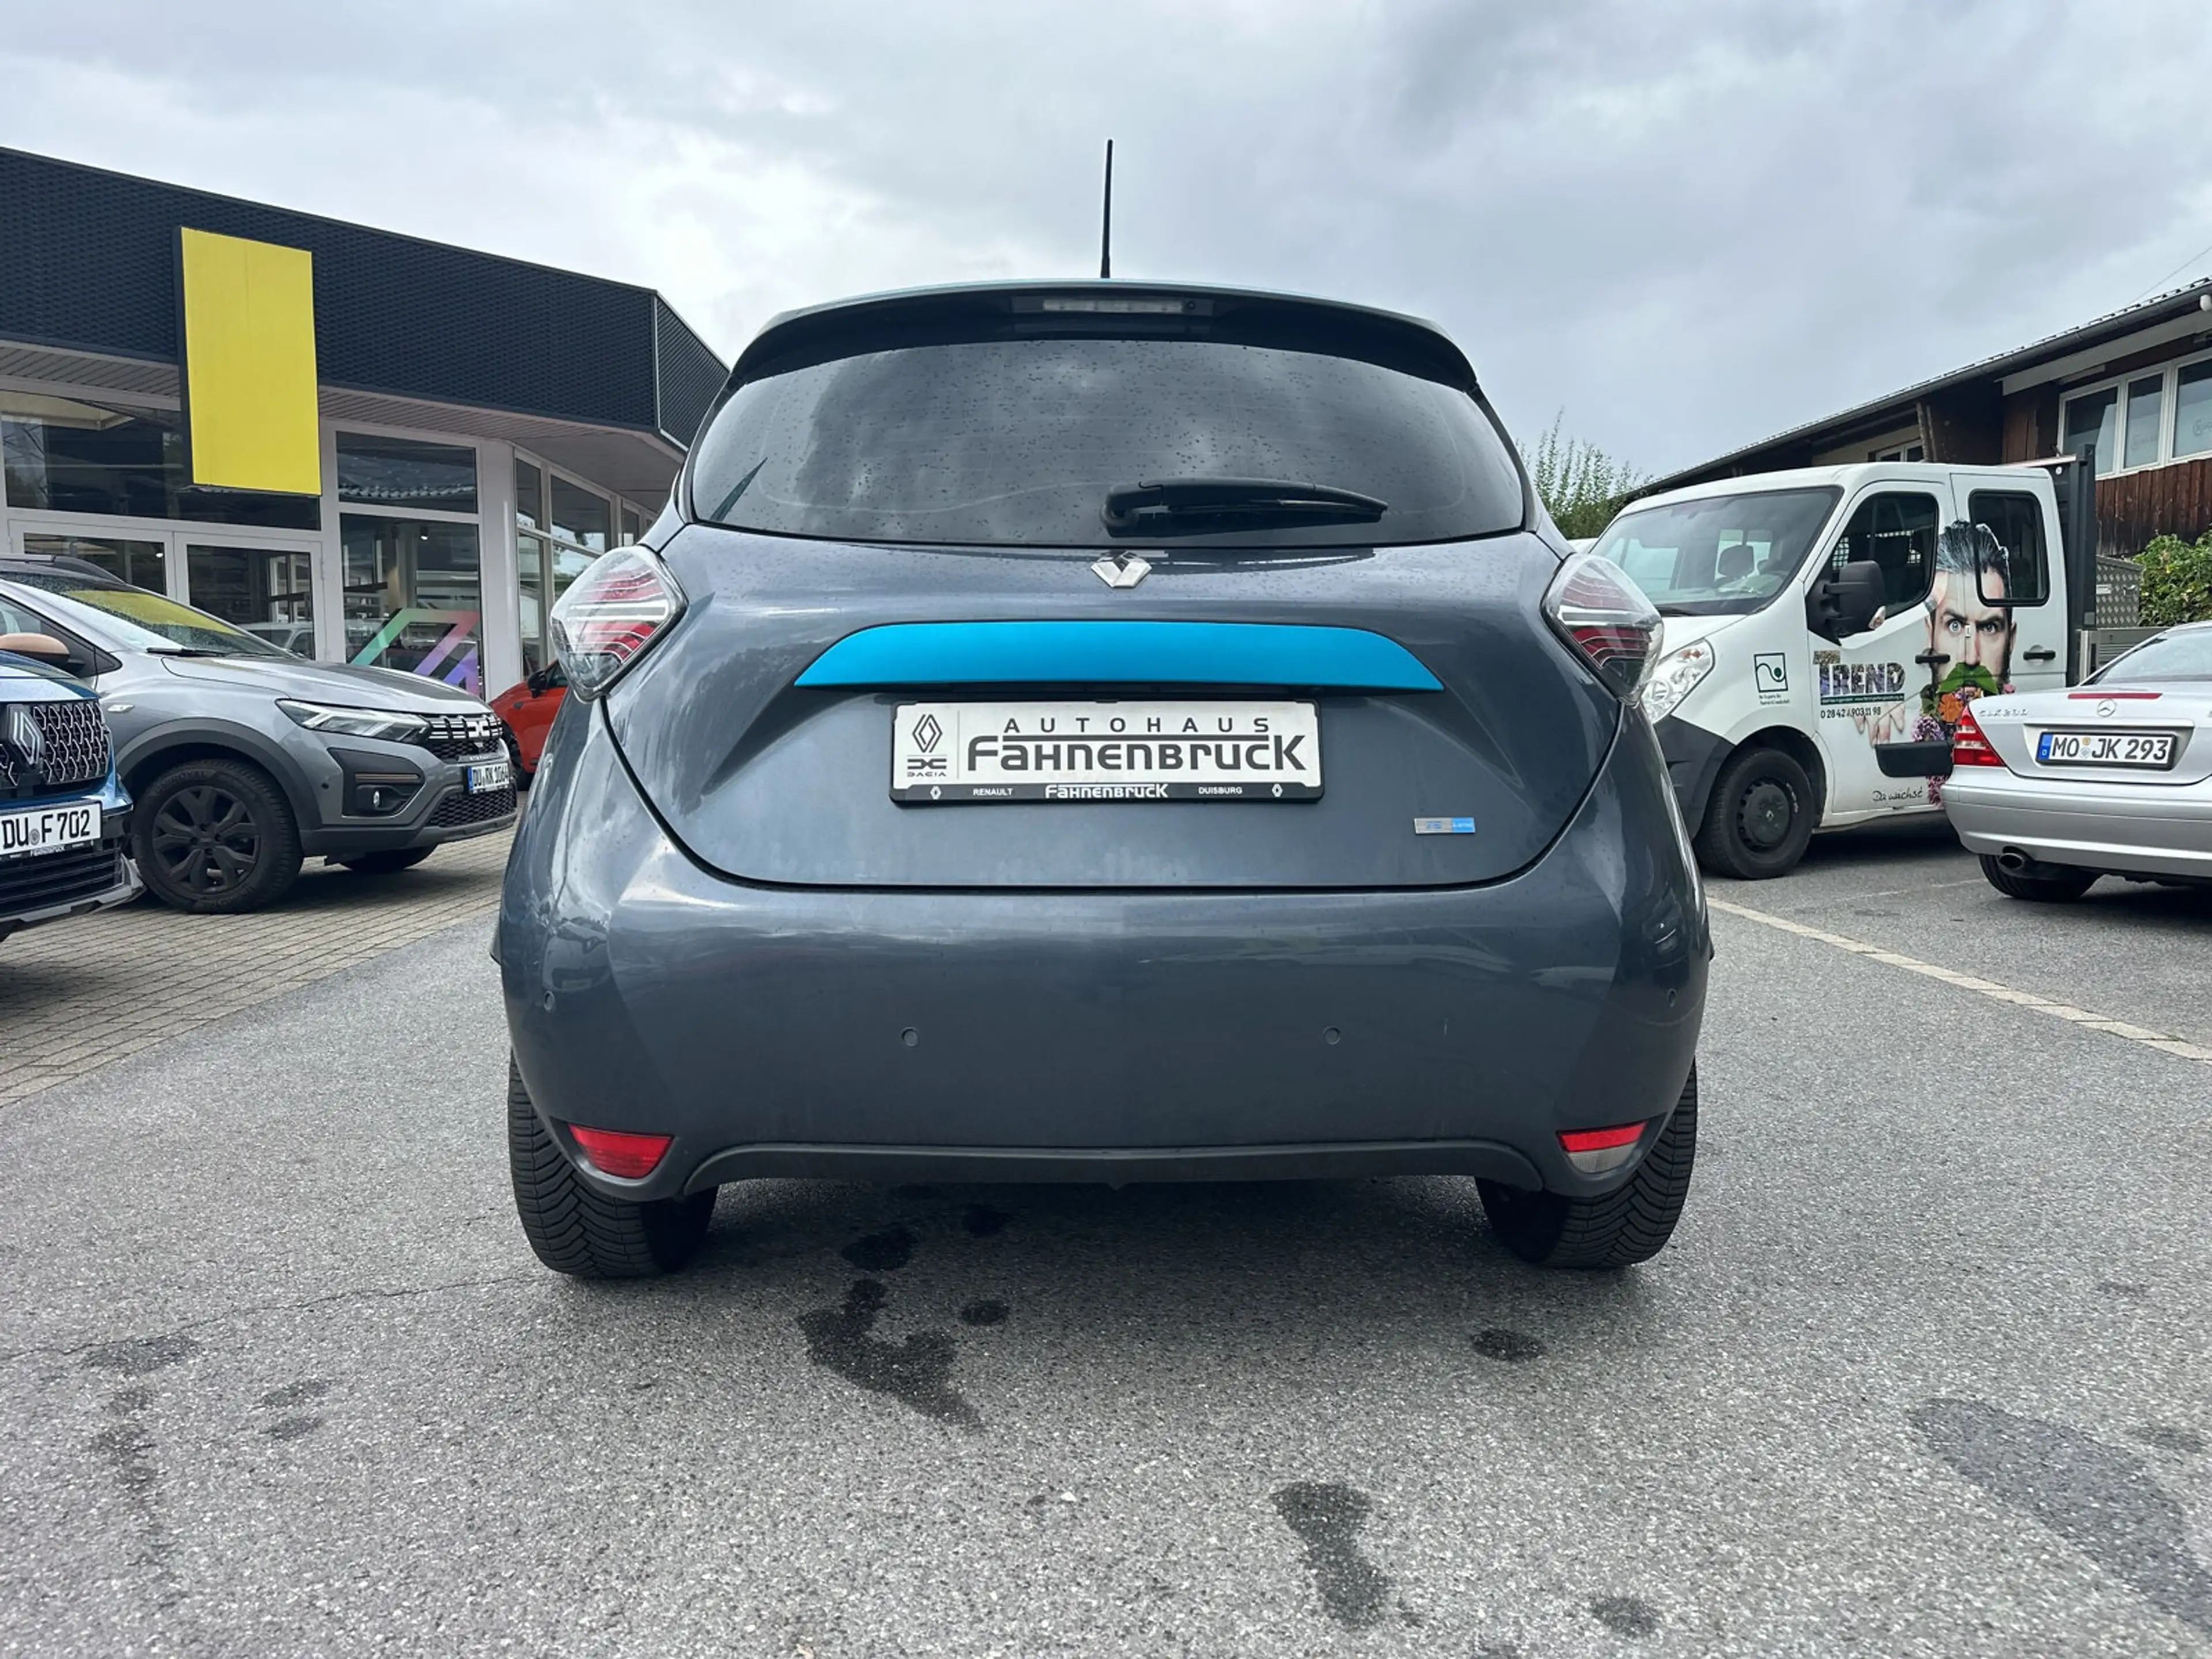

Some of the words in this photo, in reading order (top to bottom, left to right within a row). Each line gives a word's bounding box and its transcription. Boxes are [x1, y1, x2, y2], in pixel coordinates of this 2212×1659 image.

[1813, 650, 1906, 696] TREND
[1003, 717, 1269, 733] AUTOHAUS
[2051, 737, 2080, 757] MO
[2092, 738, 2121, 759] JK
[2124, 738, 2169, 760] 293
[972, 787, 1013, 796] RENAULT
[1198, 786, 1243, 795] DUISBURG
[1, 816, 29, 850] DU
[41, 813, 54, 843] F
[57, 809, 90, 840] 702
